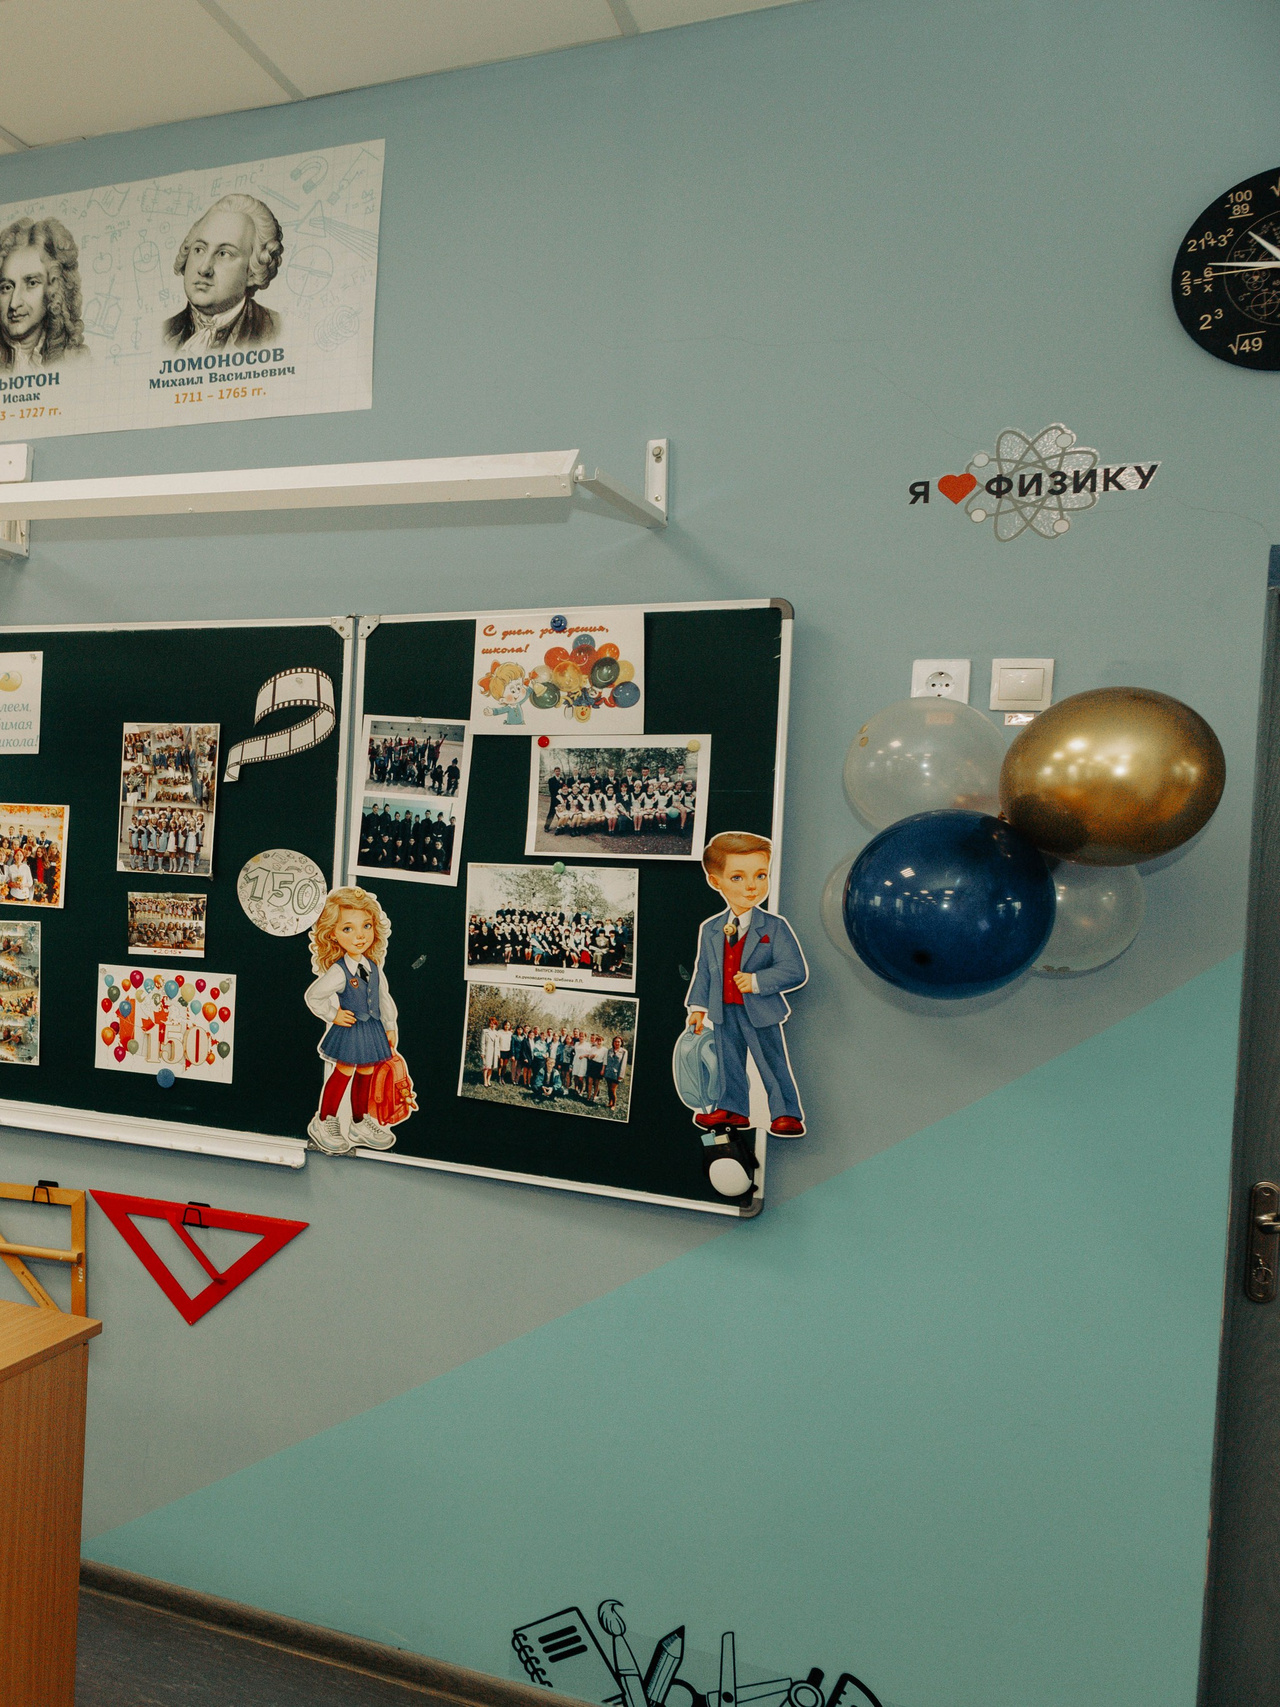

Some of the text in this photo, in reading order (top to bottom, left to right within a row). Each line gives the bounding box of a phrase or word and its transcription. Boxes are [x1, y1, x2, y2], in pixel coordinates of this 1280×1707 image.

[159, 347, 285, 375] ЛОМОНОСОВ
[149, 365, 296, 390] Михаил Васильевич
[3, 392, 41, 404] Исаак
[174, 391, 203, 404] 1711
[218, 386, 247, 400] 1765
[251, 386, 266, 397] гг.
[19, 407, 45, 419] 1727
[48, 407, 62, 416] гг.
[909, 464, 1159, 504] Я ФИЗИКУ
[483, 624, 497, 637] С
[501, 628, 535, 640] днем
[481, 643, 530, 655] школа!
[243, 866, 320, 916] 150
[145, 1022, 210, 1067] 150
